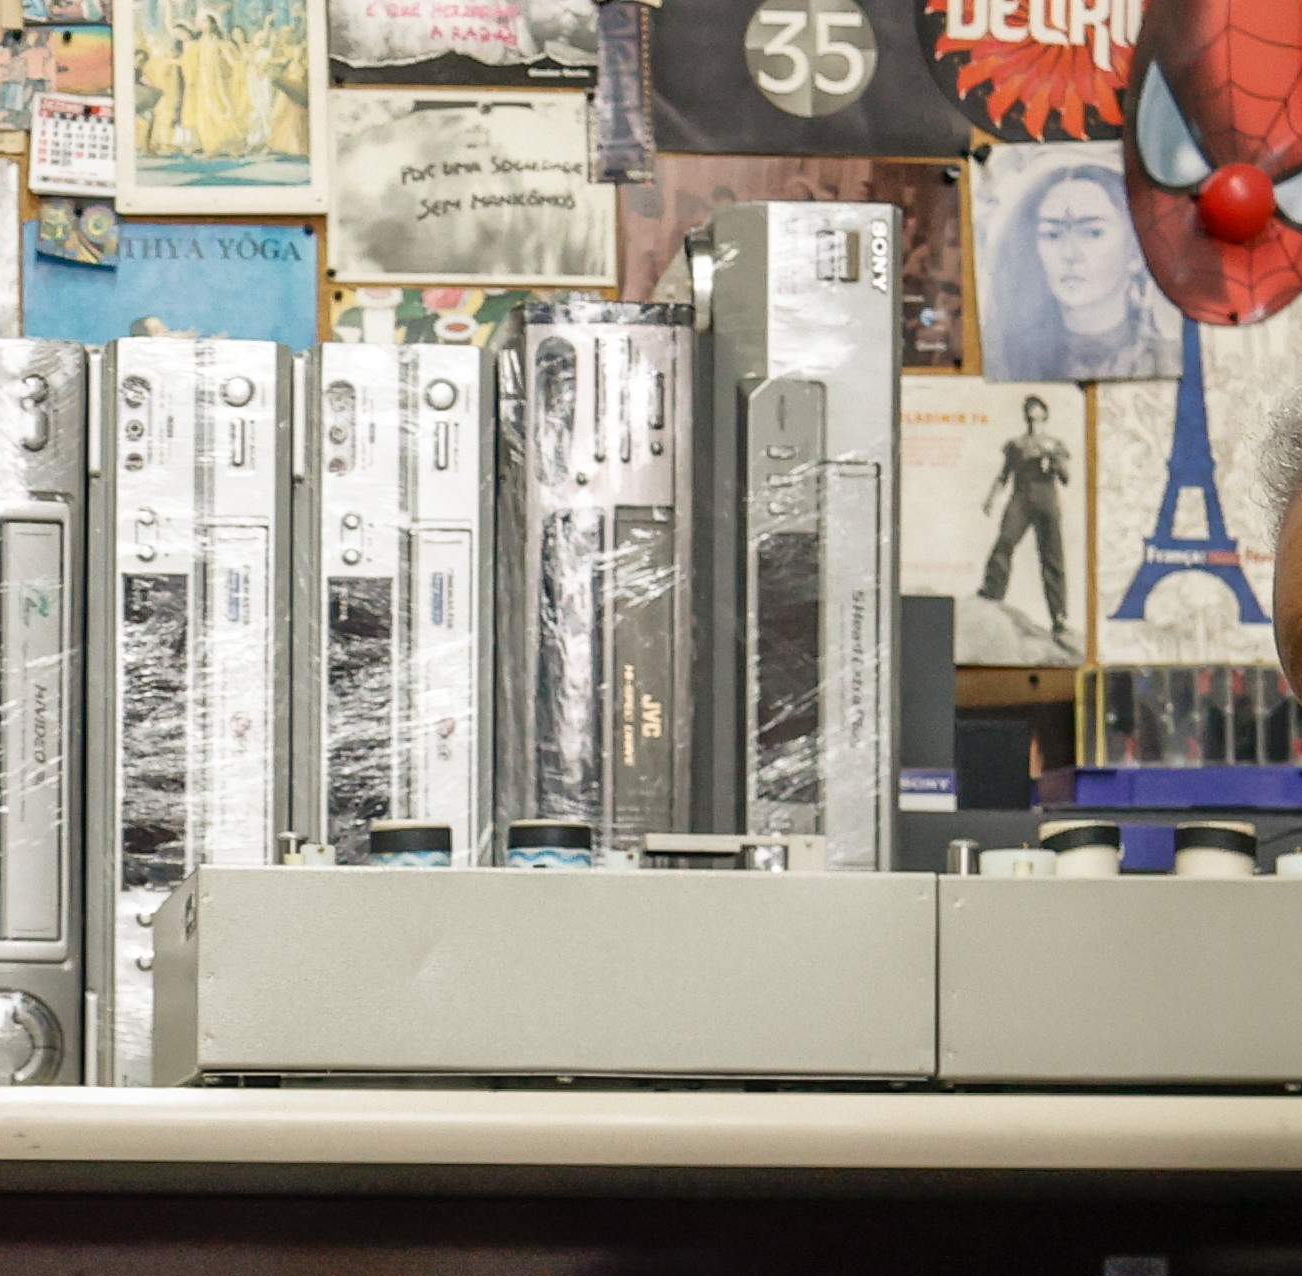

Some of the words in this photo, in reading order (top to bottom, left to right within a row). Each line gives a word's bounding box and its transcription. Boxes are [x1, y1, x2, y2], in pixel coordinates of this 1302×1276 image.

[758, 10, 866, 94] 35
[122, 237, 204, 260] THYA
[217, 233, 302, 261] YÔGA
[871, 221, 888, 291] SONY
[640, 693, 662, 739] JVC
